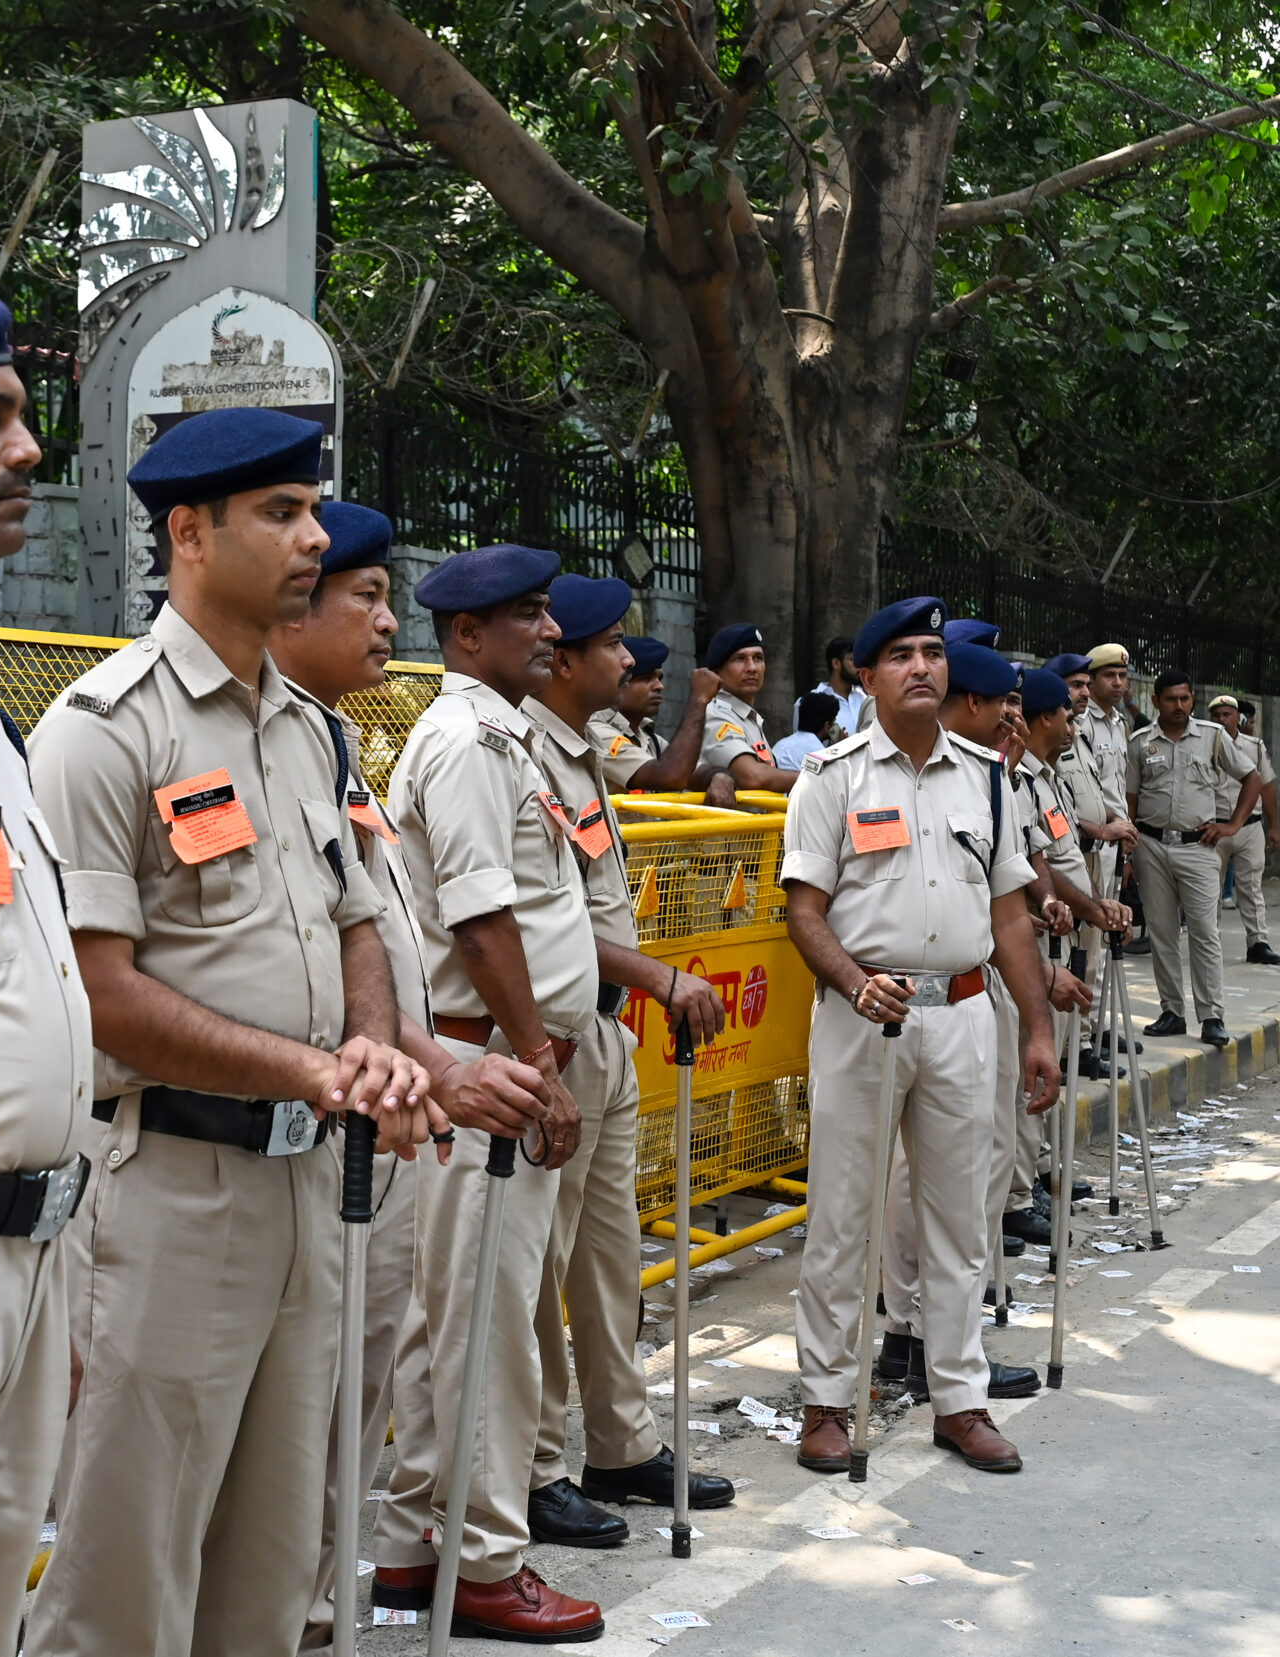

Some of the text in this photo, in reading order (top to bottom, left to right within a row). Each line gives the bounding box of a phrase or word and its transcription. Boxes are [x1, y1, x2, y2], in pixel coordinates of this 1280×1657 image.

[149, 379, 311, 398] RUGBY SEVENS COMPETITION VENUE
